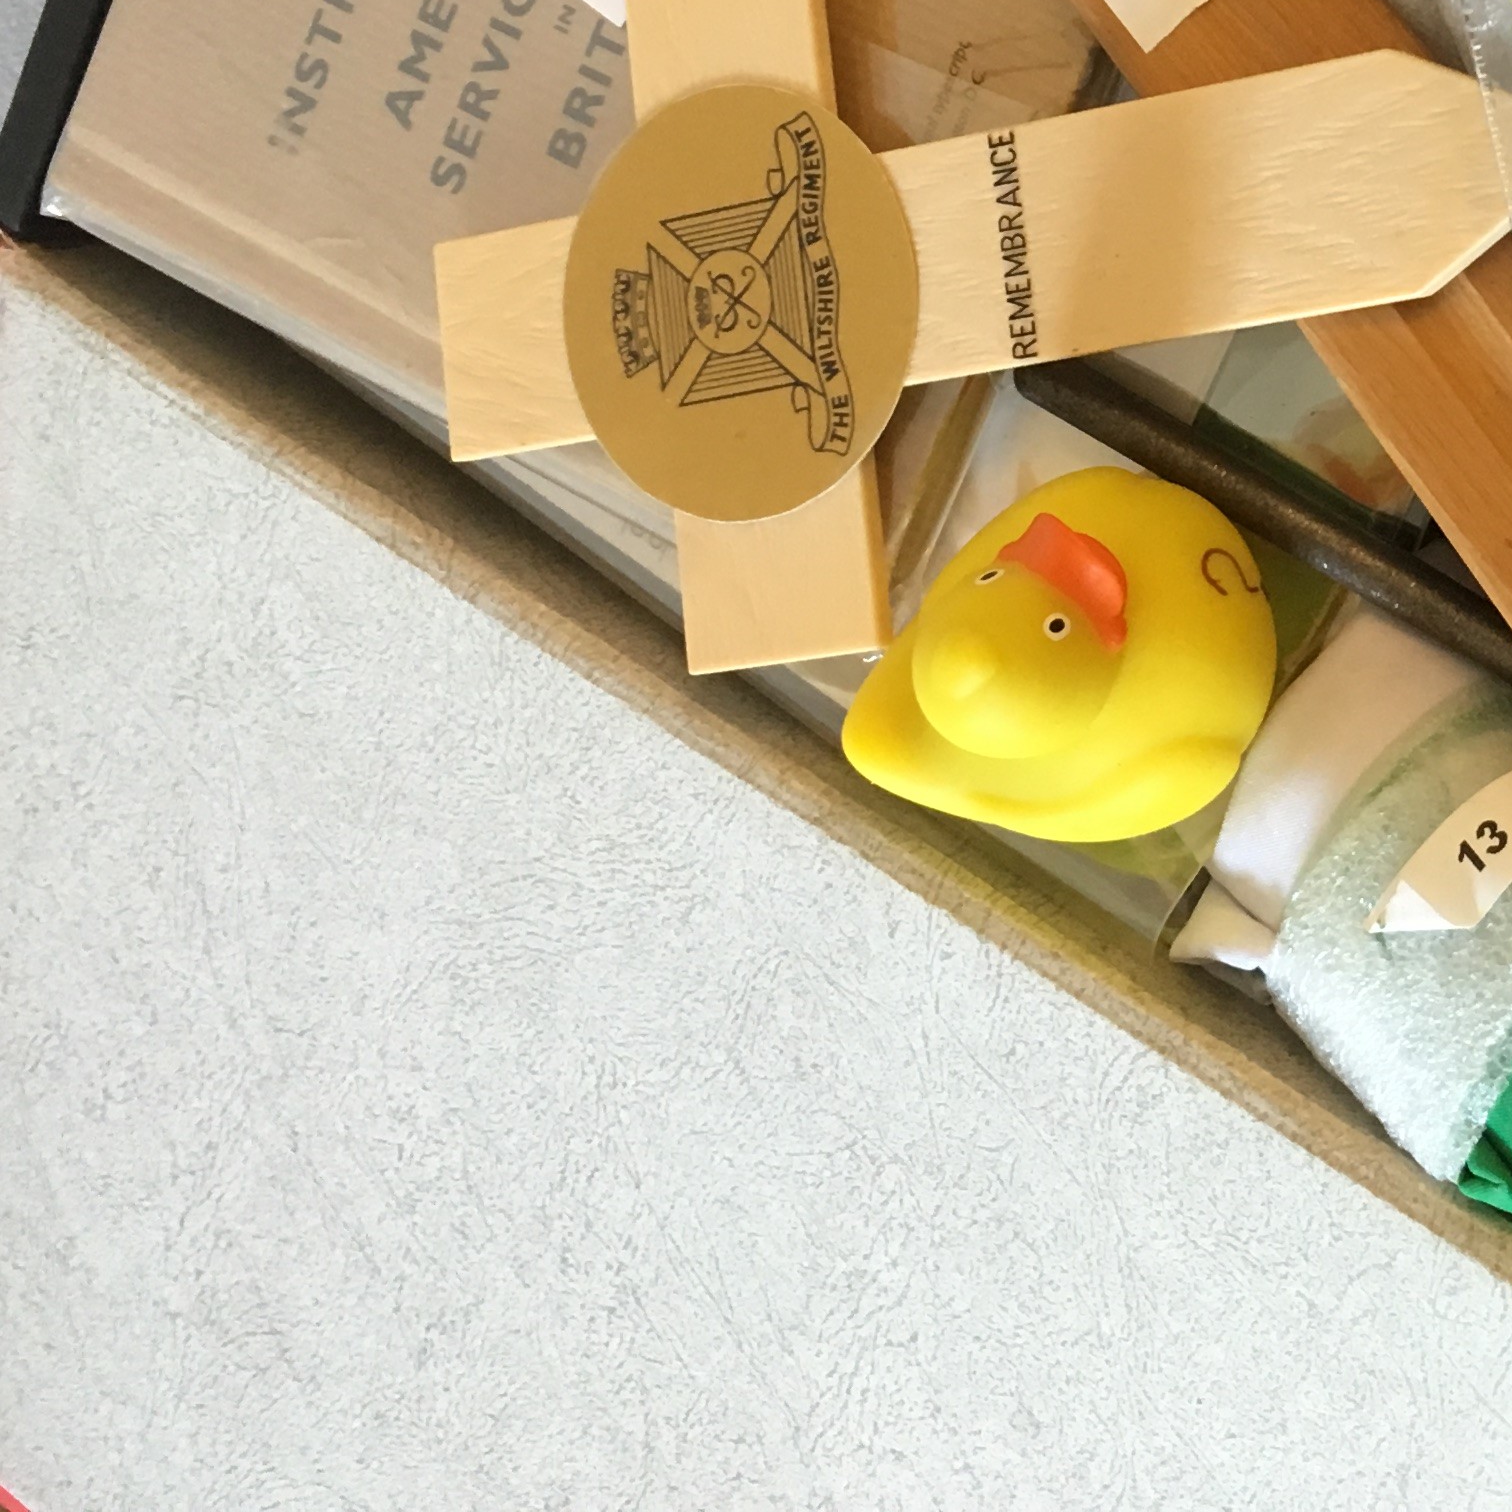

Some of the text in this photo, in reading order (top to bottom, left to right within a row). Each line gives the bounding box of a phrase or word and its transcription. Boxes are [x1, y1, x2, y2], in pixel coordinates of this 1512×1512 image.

[554, 4, 579, 36] IN
[799, 125, 851, 445] THE WILTSHIRE REGIMENT
[988, 129, 1039, 361] REMEMBRANCE
[1458, 820, 1509, 873] 13
